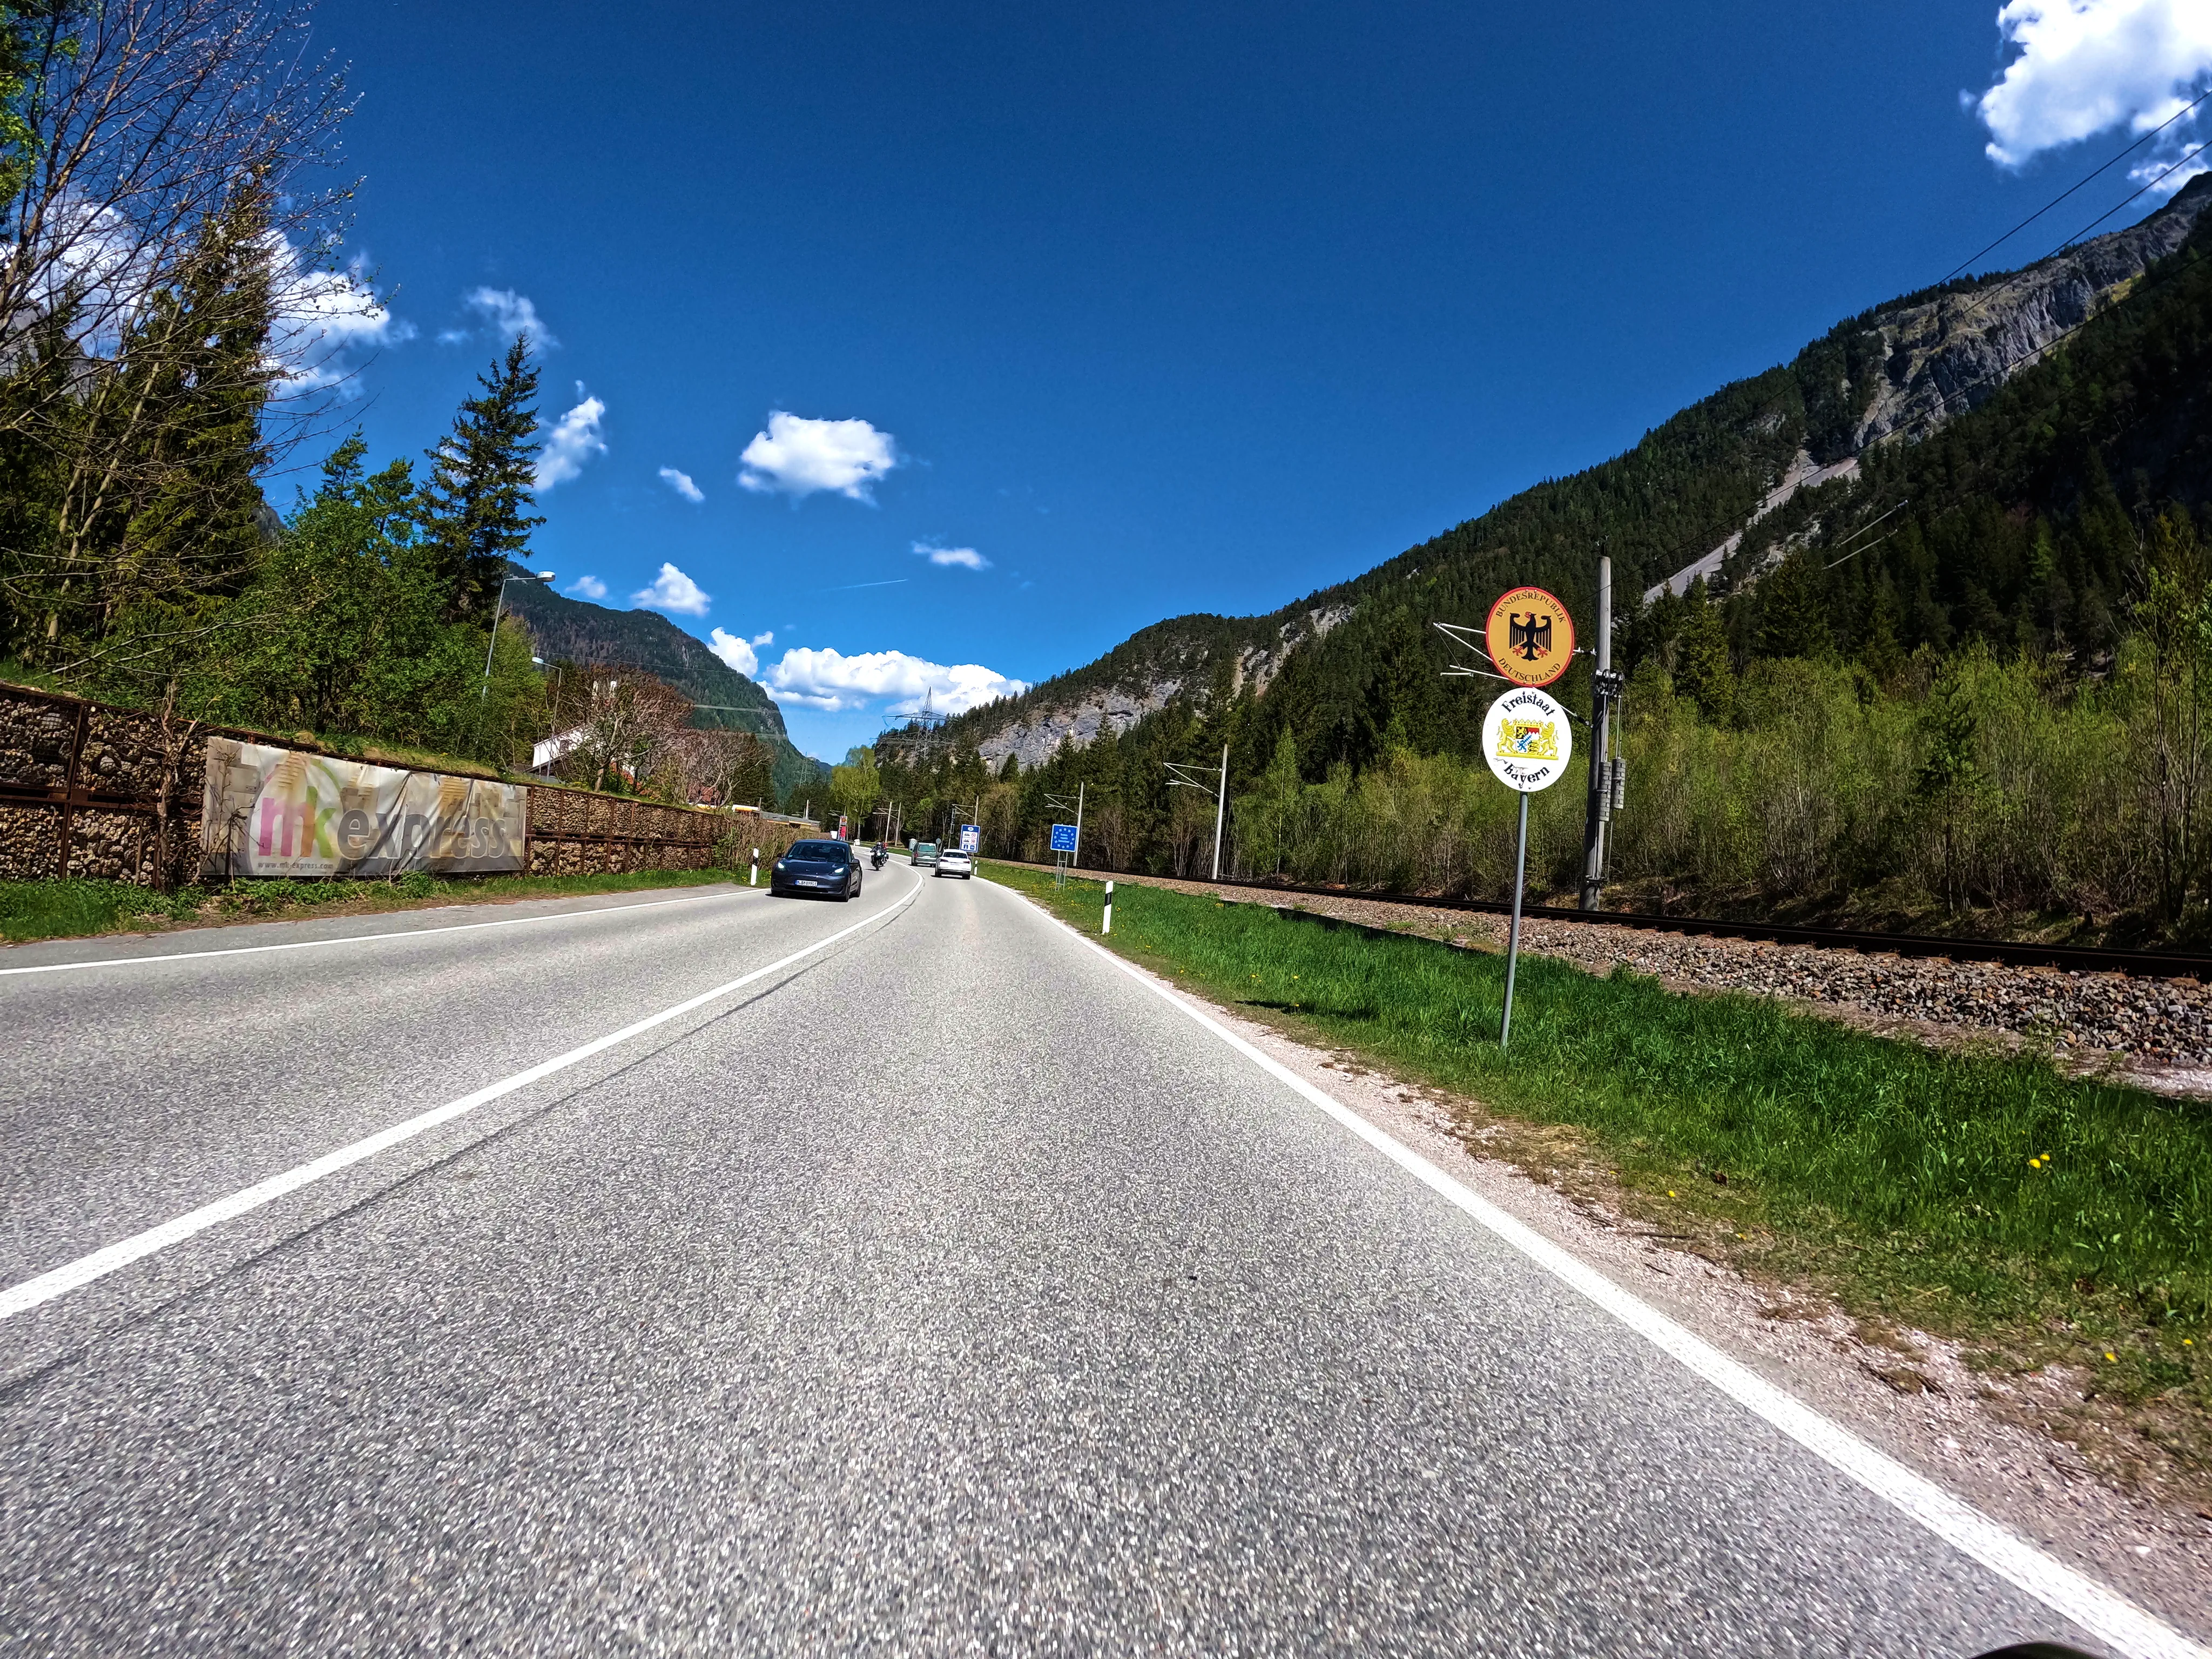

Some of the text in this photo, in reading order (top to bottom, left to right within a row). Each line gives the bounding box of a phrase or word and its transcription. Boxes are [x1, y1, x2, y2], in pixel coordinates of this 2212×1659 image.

[1495, 591, 1566, 623] BUNDESREPUBLIK
[1498, 657, 1561, 683] DEUTSCHLAND
[1501, 691, 1555, 717] Freistaat
[1503, 763, 1550, 789] Bayern
